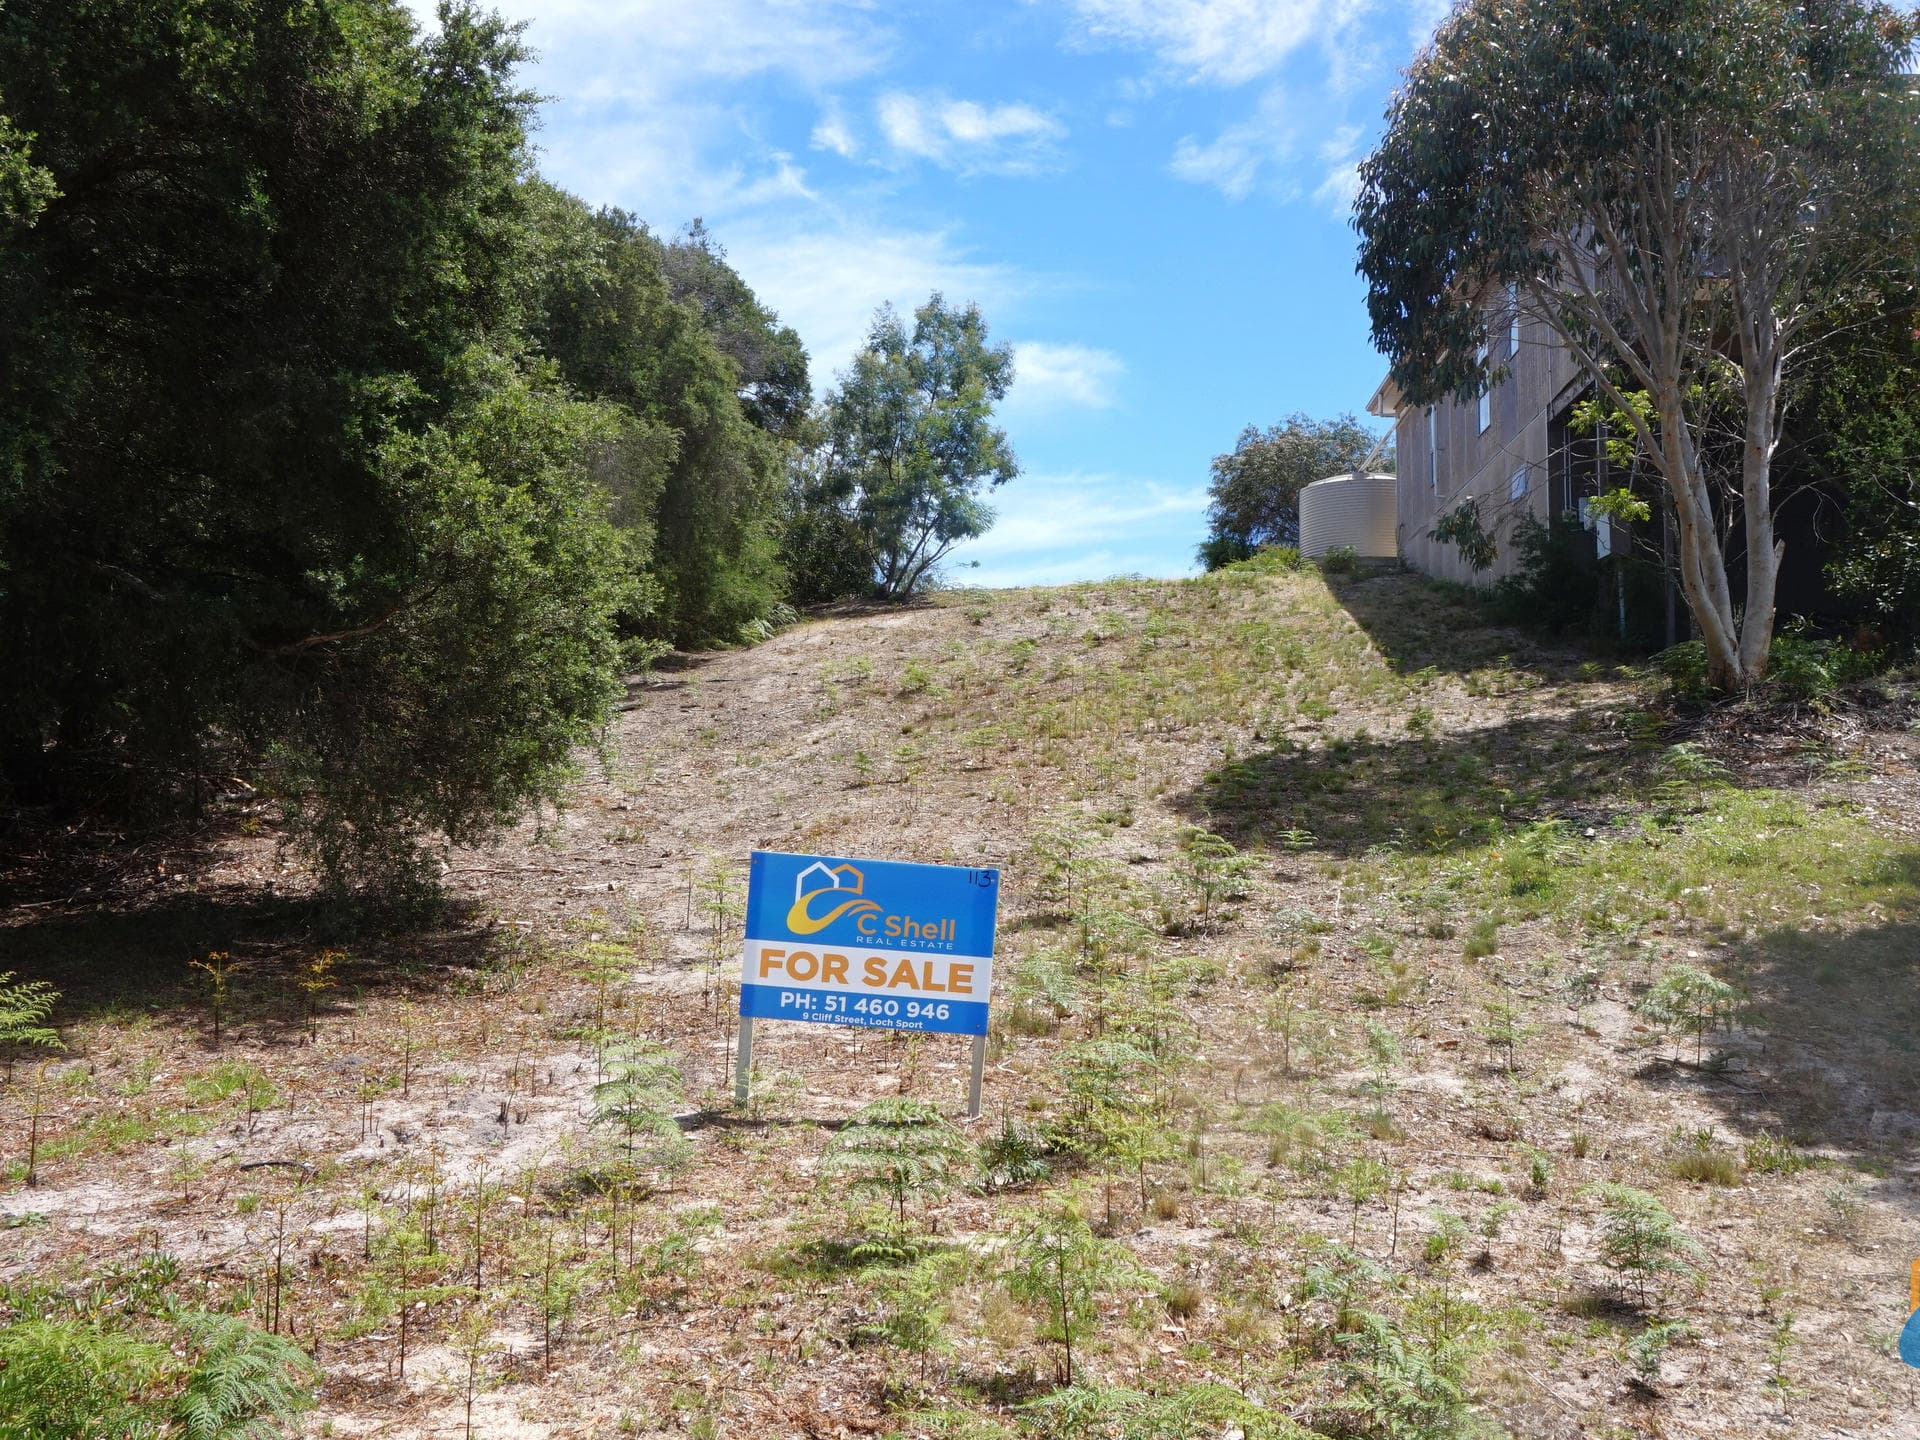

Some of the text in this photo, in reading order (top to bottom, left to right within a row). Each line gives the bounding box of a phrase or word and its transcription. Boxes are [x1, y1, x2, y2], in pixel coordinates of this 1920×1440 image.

[969, 870, 991, 887] 113
[857, 913, 956, 941] C Shell
[856, 936, 953, 950] REAL ESTATE
[759, 948, 975, 994] FOR SALE
[780, 991, 950, 1020] PH: 51 460 946
[802, 1012, 923, 1029] 9 Cliff Street, Loch Sport
